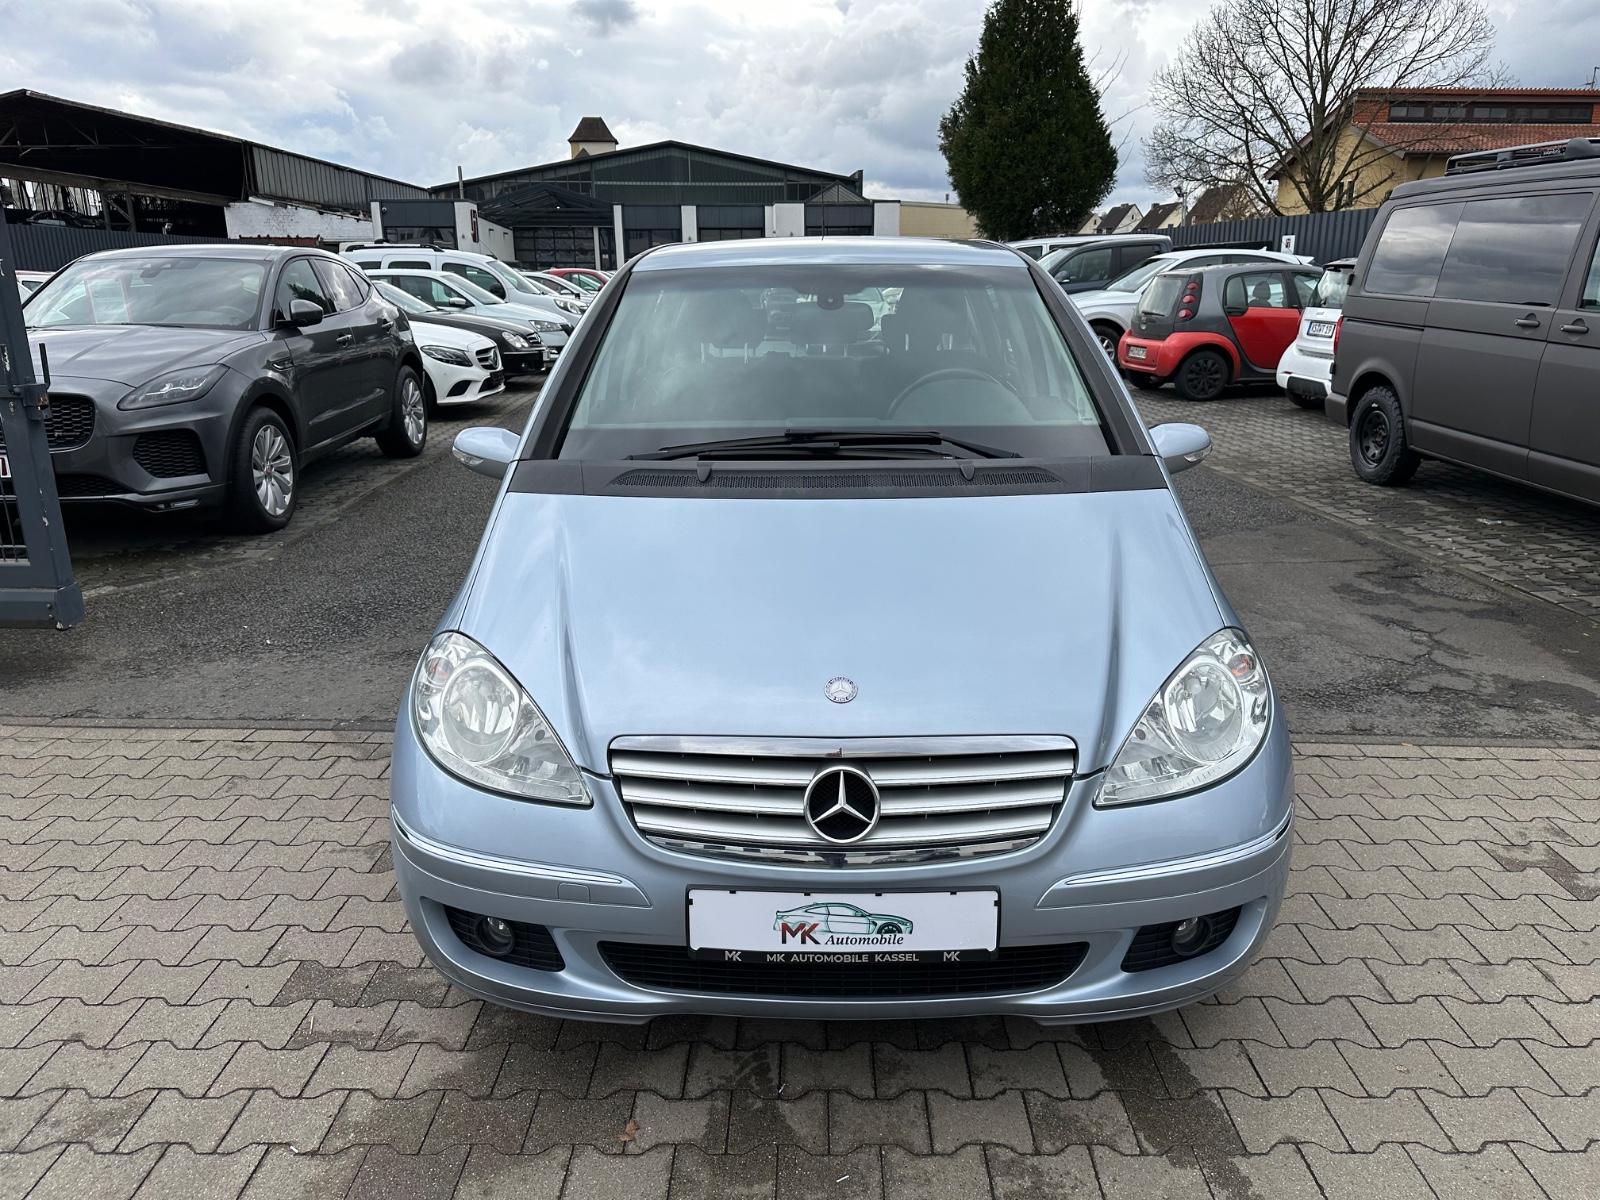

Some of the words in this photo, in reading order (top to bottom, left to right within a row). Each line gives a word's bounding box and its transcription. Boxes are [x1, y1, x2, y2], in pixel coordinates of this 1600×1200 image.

[781, 922, 820, 945] MK
[824, 934, 904, 946] Automobile
[724, 950, 742, 962] MK
[766, 953, 785, 962] MK
[790, 953, 869, 963] AUTOMOBILE
[874, 953, 920, 962] KASSEL
[943, 951, 961, 962] MK
